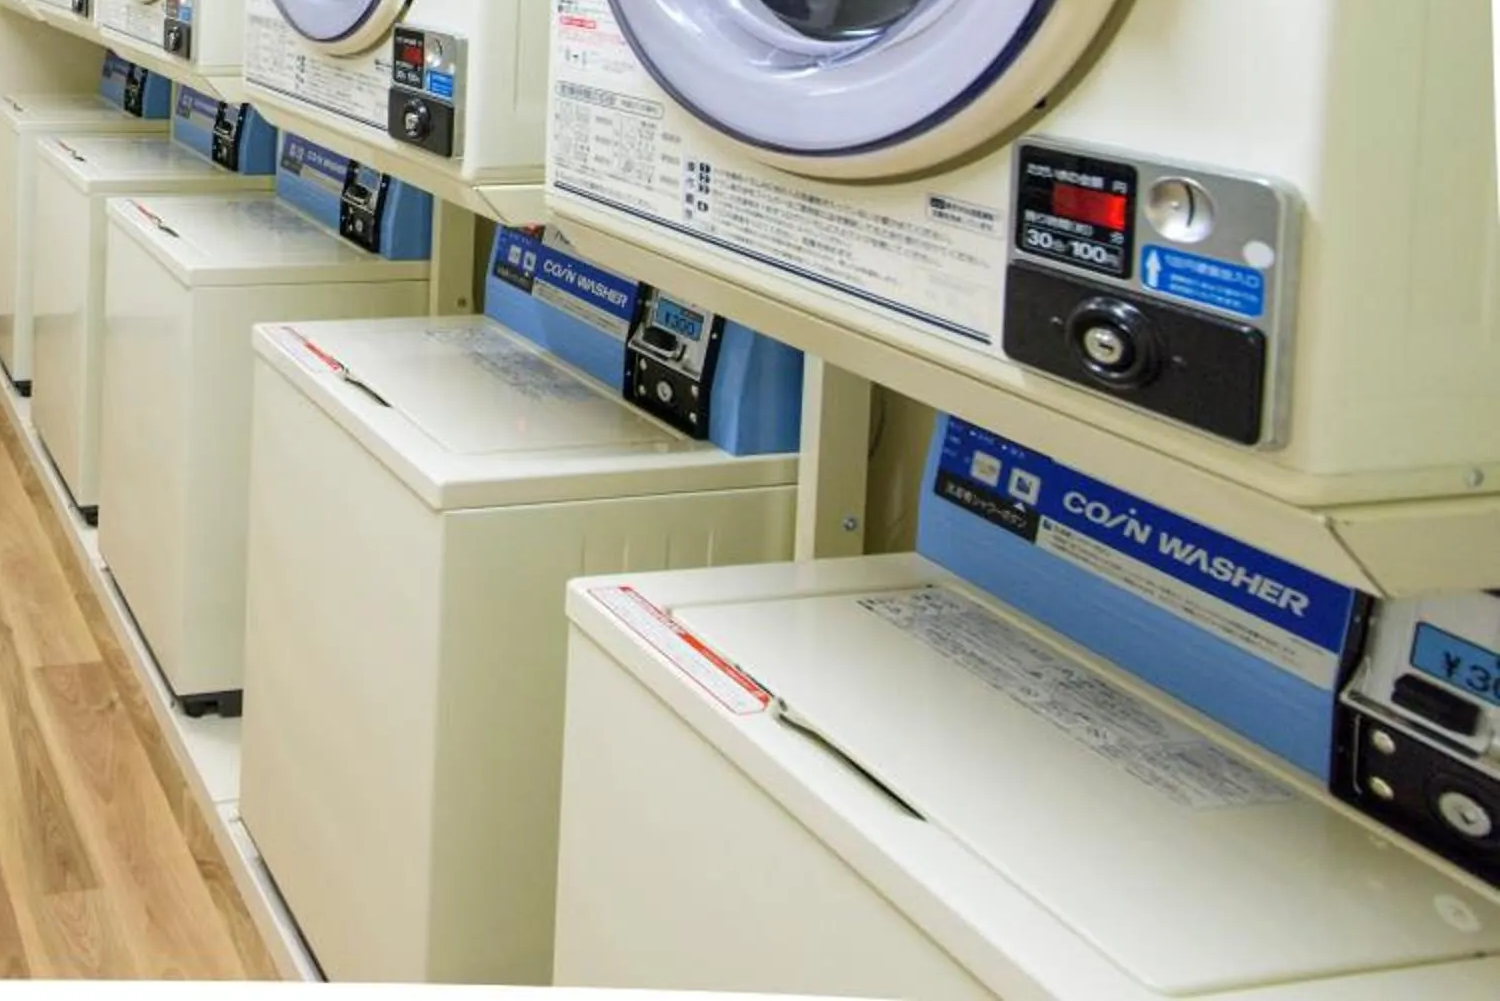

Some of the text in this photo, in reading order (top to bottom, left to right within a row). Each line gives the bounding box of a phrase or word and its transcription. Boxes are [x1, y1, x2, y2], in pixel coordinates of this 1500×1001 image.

[577, 273, 628, 308] WASHER
[1063, 490, 1153, 544] COIN
[1158, 531, 1310, 618] WASHER
